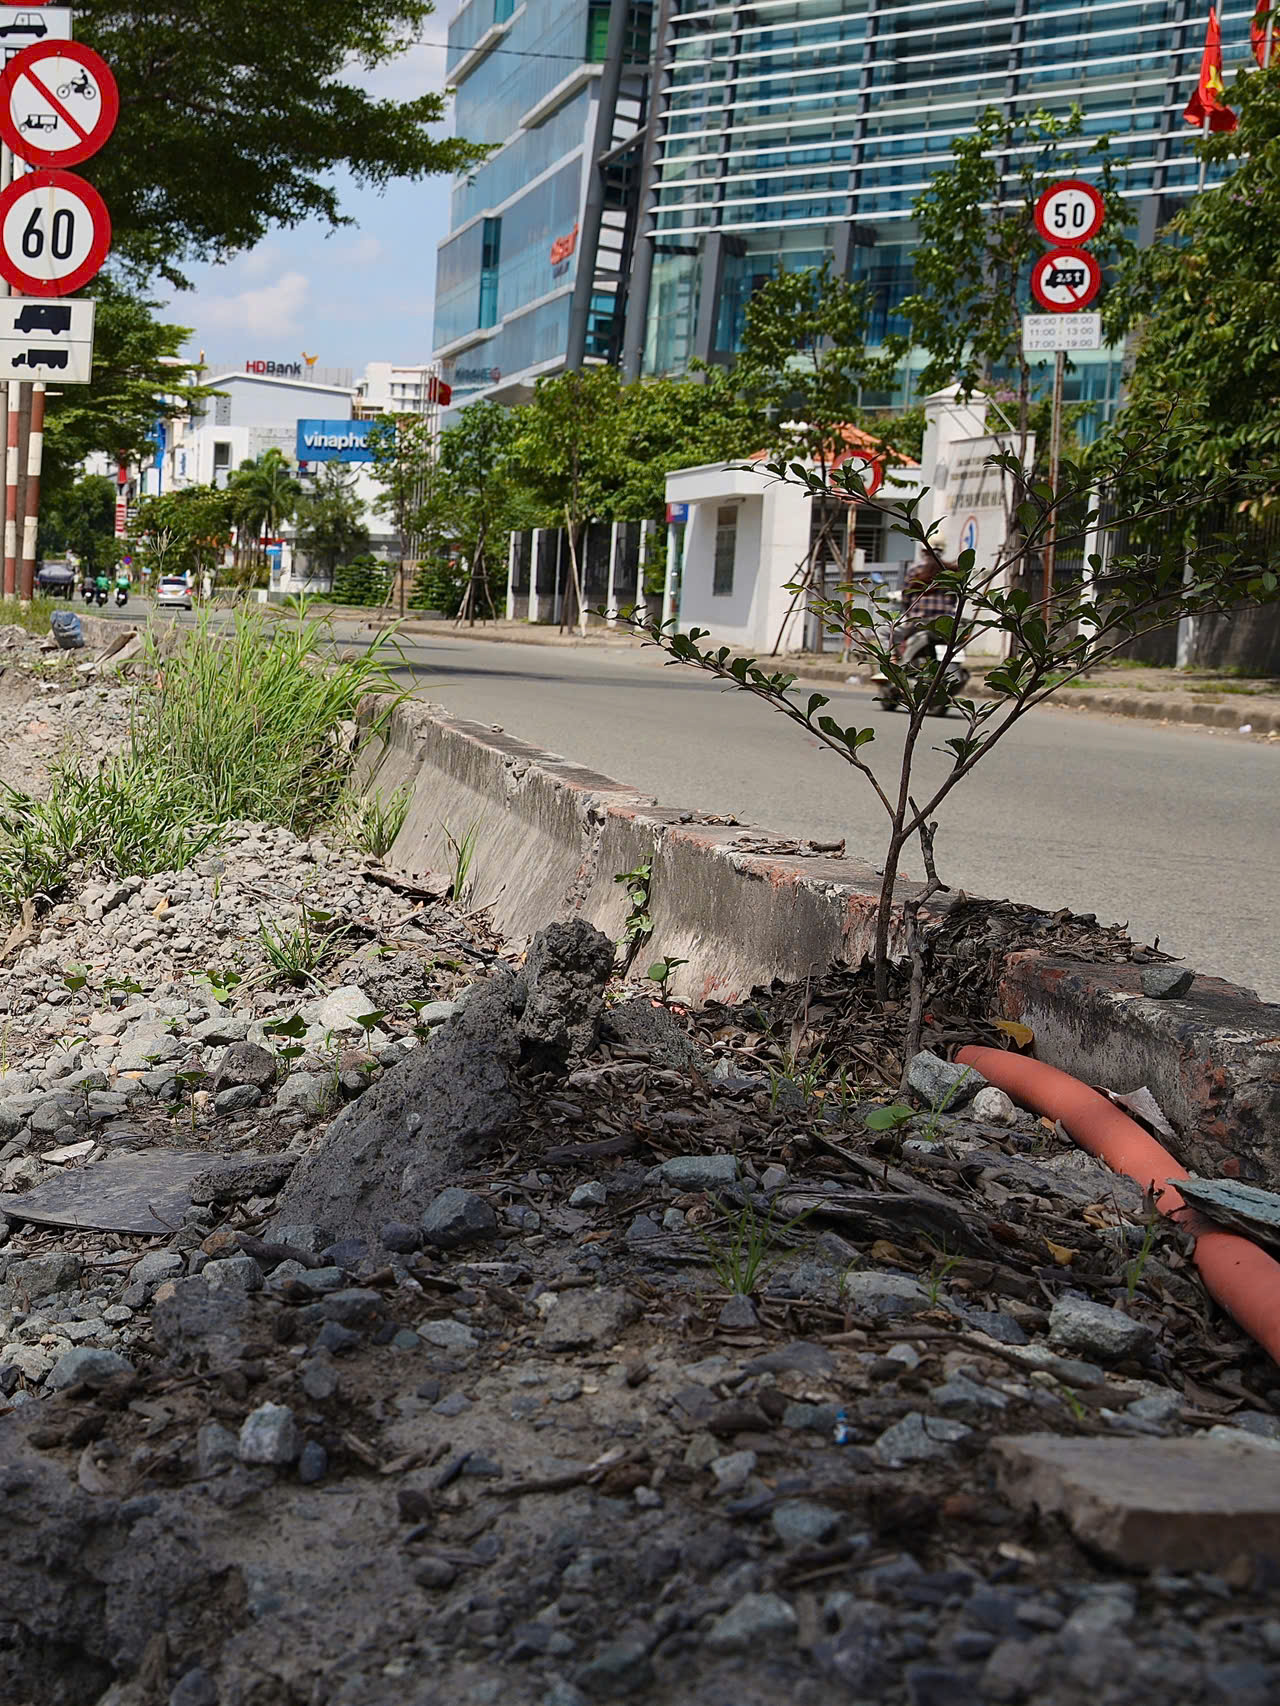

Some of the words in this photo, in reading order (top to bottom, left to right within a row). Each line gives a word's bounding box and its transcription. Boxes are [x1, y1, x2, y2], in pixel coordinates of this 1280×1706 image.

[1054, 202, 1085, 228] 50
[22, 207, 75, 259] 60
[245, 359, 301, 375] HDBank
